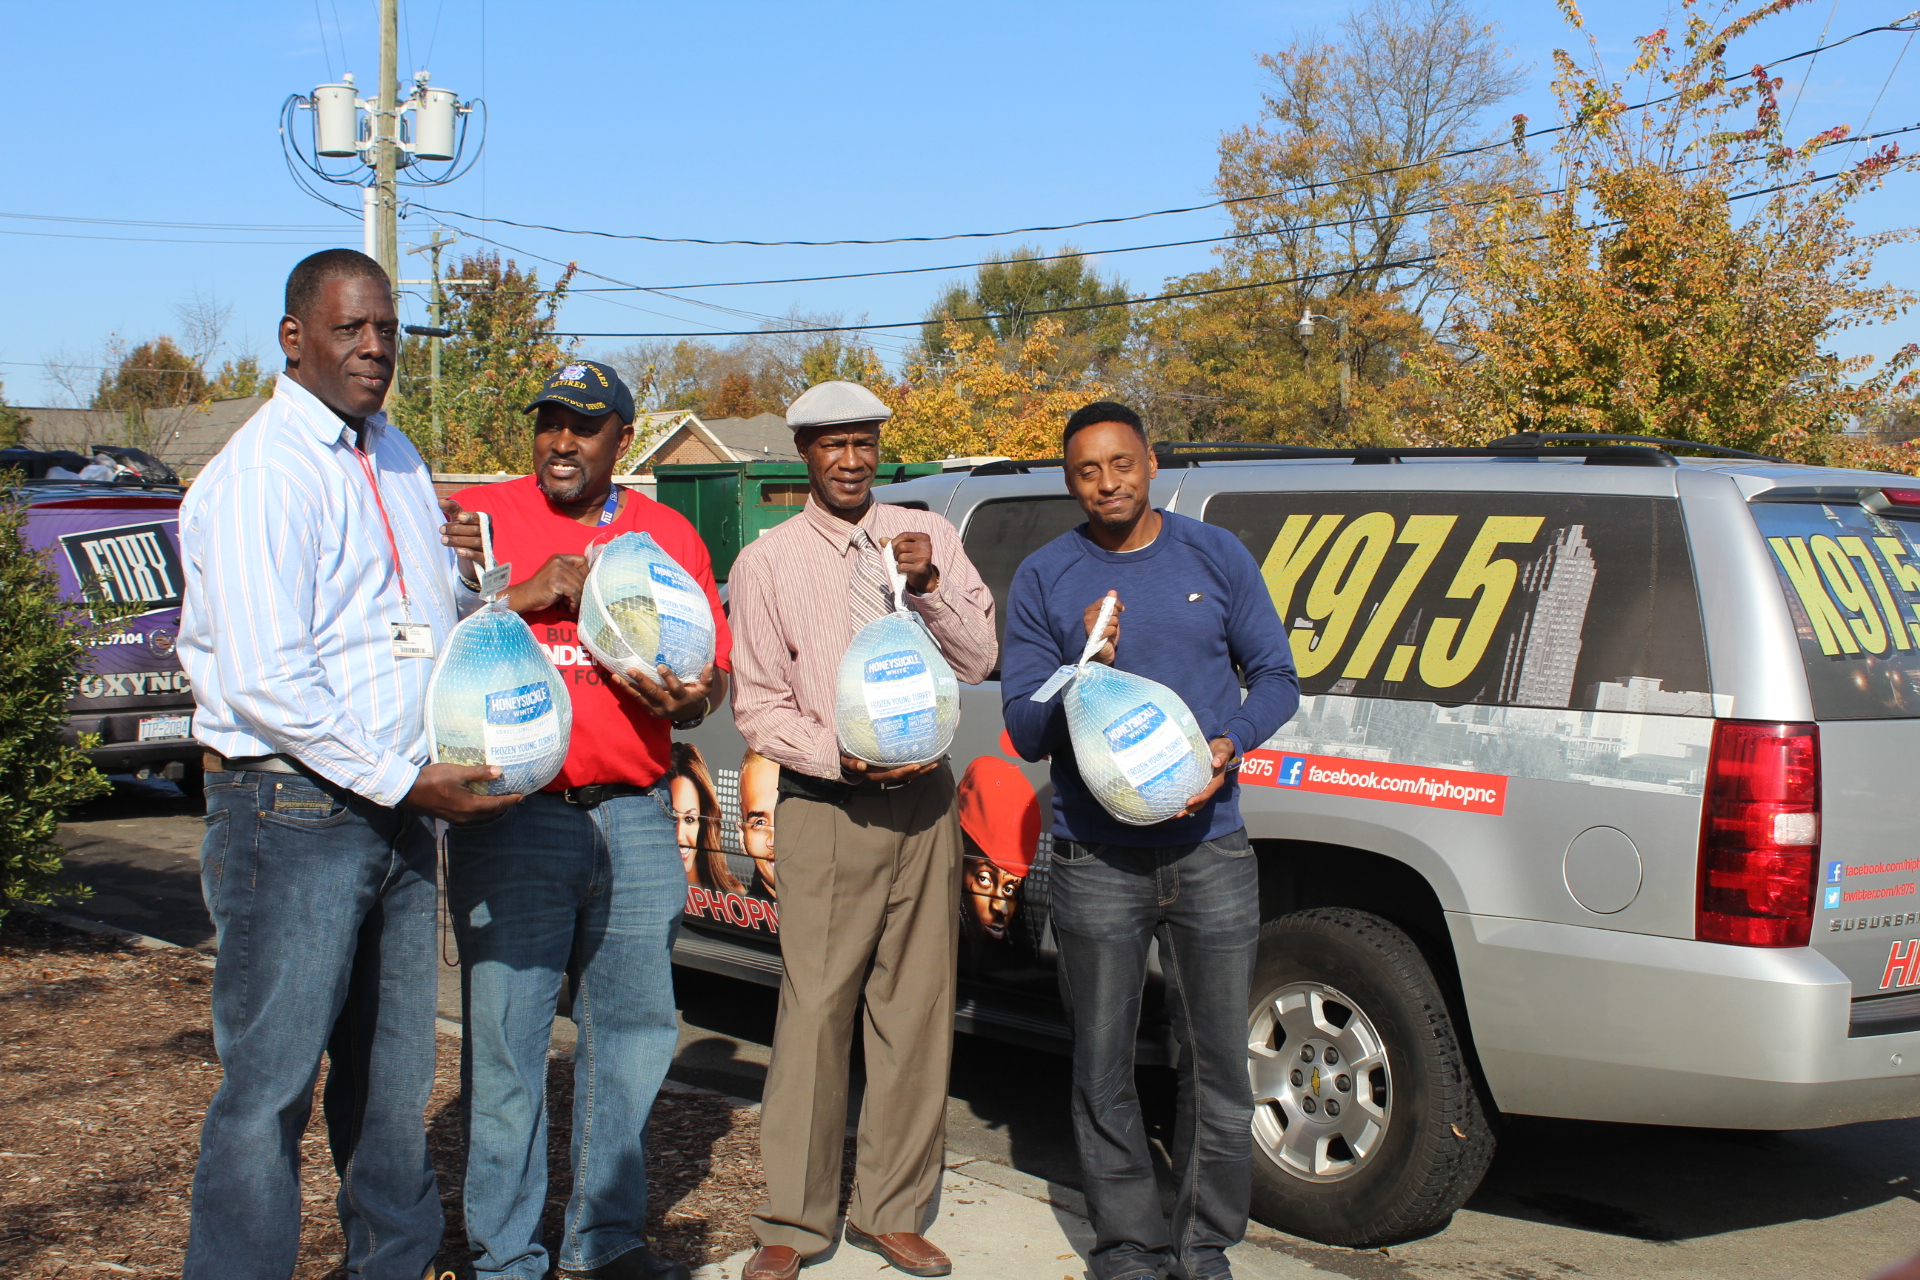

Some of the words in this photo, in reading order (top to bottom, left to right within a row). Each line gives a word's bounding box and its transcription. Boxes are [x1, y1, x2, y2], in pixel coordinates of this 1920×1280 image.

[550, 380, 587, 389] RETIRED
[81, 531, 177, 602] FOXY
[1258, 511, 1545, 688] K97.5
[868, 654, 920, 673] HONEYSUCKLE
[1041, 674, 1065, 695] FROZEN
[491, 687, 548, 712] HONEYSUCKLE
[870, 698, 891, 709] FROZEN
[892, 695, 911, 705] YOUNG
[912, 690, 932, 701] TURKEY
[513, 707, 535, 717] WHITE
[1108, 706, 1158, 741] HONEYSUCKLE
[1128, 723, 1150, 739] WHITE
[490, 745, 516, 756] FROZEN
[517, 740, 537, 753] YOUNG
[1127, 761, 1149, 777] FROZEN
[1147, 749, 1167, 766] YOUNG
[1165, 736, 1184, 754] TURKEY
[1308, 765, 1497, 806] facebook.com/hiphopnc
[1843, 882, 1917, 902] twitter.com/k975
[684, 886, 779, 934] IPHOPN
[1878, 938, 1920, 990] HI
